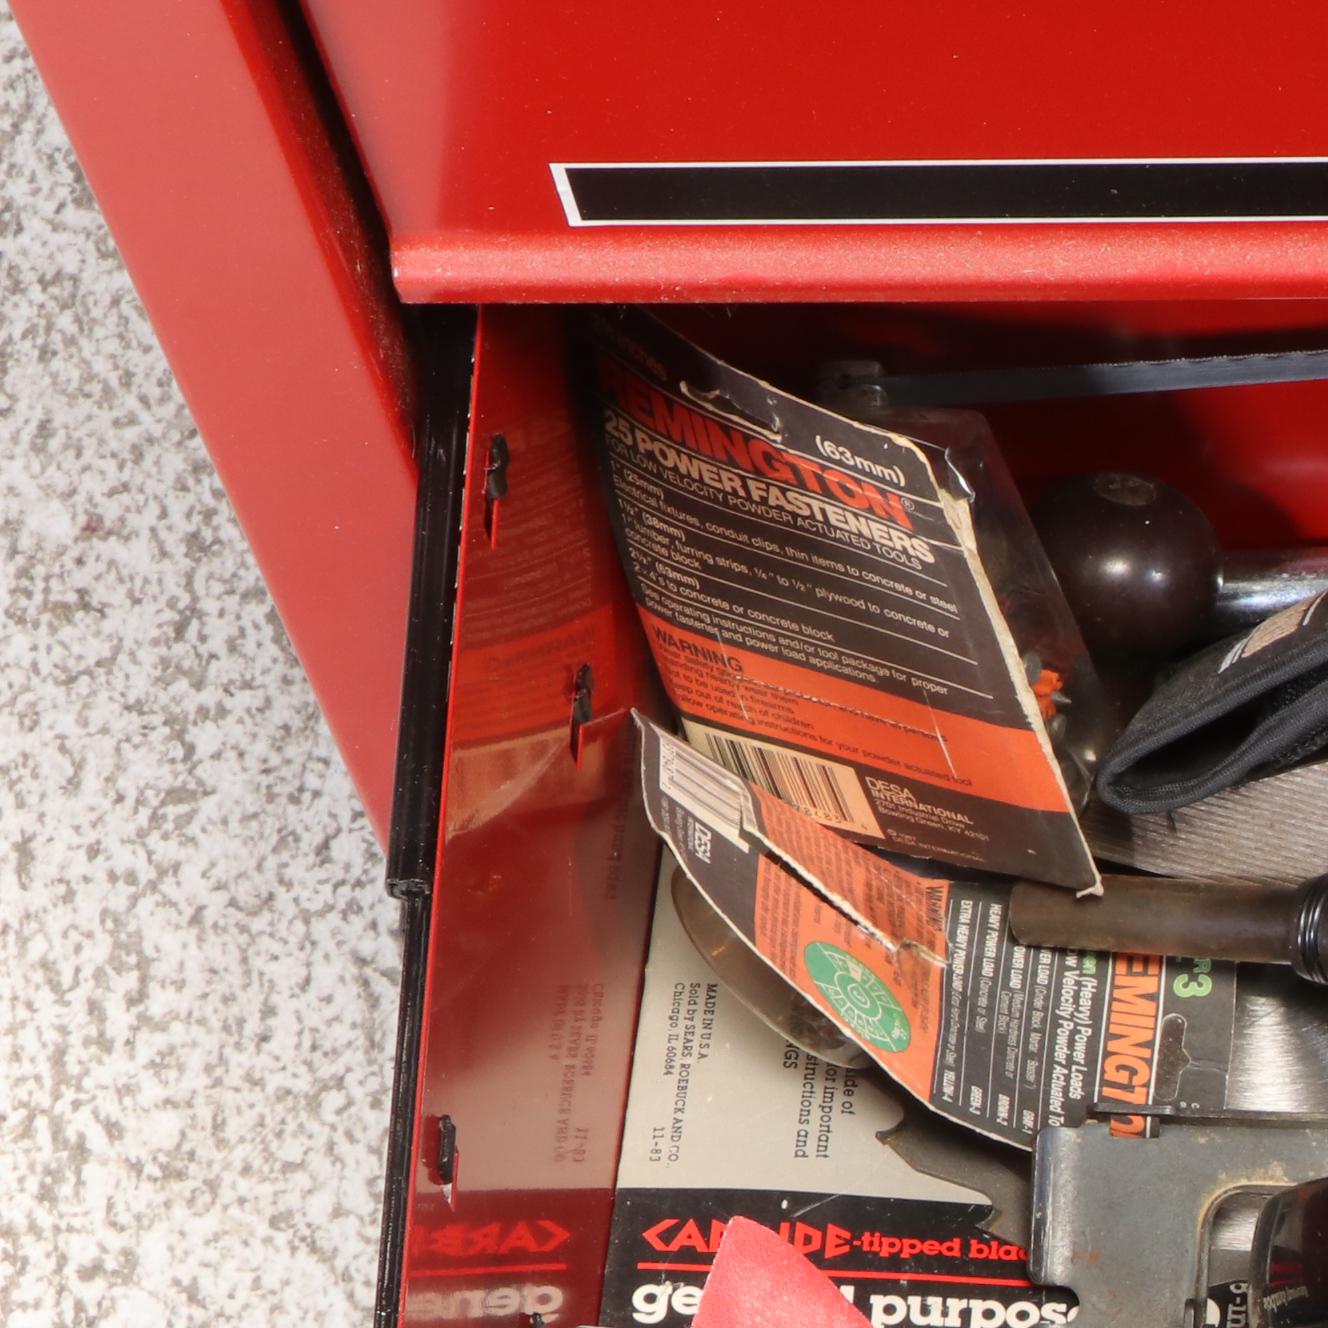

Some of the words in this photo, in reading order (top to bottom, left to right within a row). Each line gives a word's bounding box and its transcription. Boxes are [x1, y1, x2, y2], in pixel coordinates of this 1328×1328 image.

[815, 434, 906, 488] (63mm)
[605, 409, 632, 447] 25
[634, 429, 748, 498] POWER
[748, 478, 936, 565] FASTENERS
[632, 453, 658, 475] LOW
[661, 466, 724, 503] VELOCITY
[727, 495, 794, 527] POWDER
[796, 516, 872, 551] ACTUATED
[876, 542, 923, 571] TOOLS
[641, 510, 686, 543] (38mm)
[655, 559, 700, 590] (63mm)
[671, 549, 701, 570] block
[705, 521, 749, 544] conduit
[784, 546, 809, 562] thin
[811, 554, 845, 574] items
[847, 564, 860, 577] to
[861, 570, 914, 597] concrete
[915, 589, 928, 602] or
[928, 594, 959, 615] steel
[674, 539, 715, 567] furring
[776, 574, 790, 588] to
[815, 586, 866, 611] plywood
[867, 602, 881, 615] to
[883, 606, 936, 634] concrete
[937, 626, 950, 639] or
[679, 583, 730, 611] concrete
[732, 603, 744, 615] or
[747, 608, 800, 633] concrete
[801, 624, 836, 643] block
[651, 622, 744, 674] WARNING
[661, 595, 711, 625] operating
[711, 614, 777, 644] instructions
[778, 635, 816, 655] and/or
[817, 646, 839, 662] tool
[840, 654, 891, 678] package
[891, 668, 908, 682] for
[910, 676, 949, 697] proper
[721, 627, 744, 643] and
[744, 636, 780, 655] power
[781, 645, 806, 662] load
[808, 655, 880, 684] applications.
[864, 776, 915, 800] DESA
[871, 790, 975, 825] INTERNATIONAL
[694, 820, 712, 865] DESA
[958, 899, 974, 924] EXTRA
[987, 903, 1003, 931] HEAVY
[954, 923, 970, 950] HEAVY
[983, 929, 999, 959] POWER
[951, 948, 967, 975] POWER
[981, 957, 996, 978] LOAD
[1036, 964, 1050, 986] LOAD
[686, 981, 702, 1007] Sold
[1008, 969, 1023, 990] LOAD
[1054, 969, 1081, 1019] Velocity
[1173, 973, 1213, 999] 3
[668, 981, 686, 1032] Chicago,
[683, 1006, 699, 1022] by
[704, 982, 719, 1016] MADE
[1073, 976, 1099, 1025] (Heavy)
[667, 1032, 679, 1044] IL
[701, 1017, 714, 1032] IN
[1053, 1018, 1075, 1065] Powder
[663, 1043, 678, 1078] 60684
[1072, 1024, 1092, 1065] Power
[1102, 951, 1161, 1138] EMINGTO
[673, 1062, 692, 1115] ROEBUCK
[797, 1051, 817, 1127] structions
[1049, 1064, 1070, 1115] Actuated
[1068, 1065, 1088, 1101] Loads
[815, 1082, 838, 1160] important
[840, 1098, 856, 1117] of
[648, 1126, 666, 1163] 11-83
[670, 1116, 687, 1143] AND
[793, 1128, 811, 1160] and
